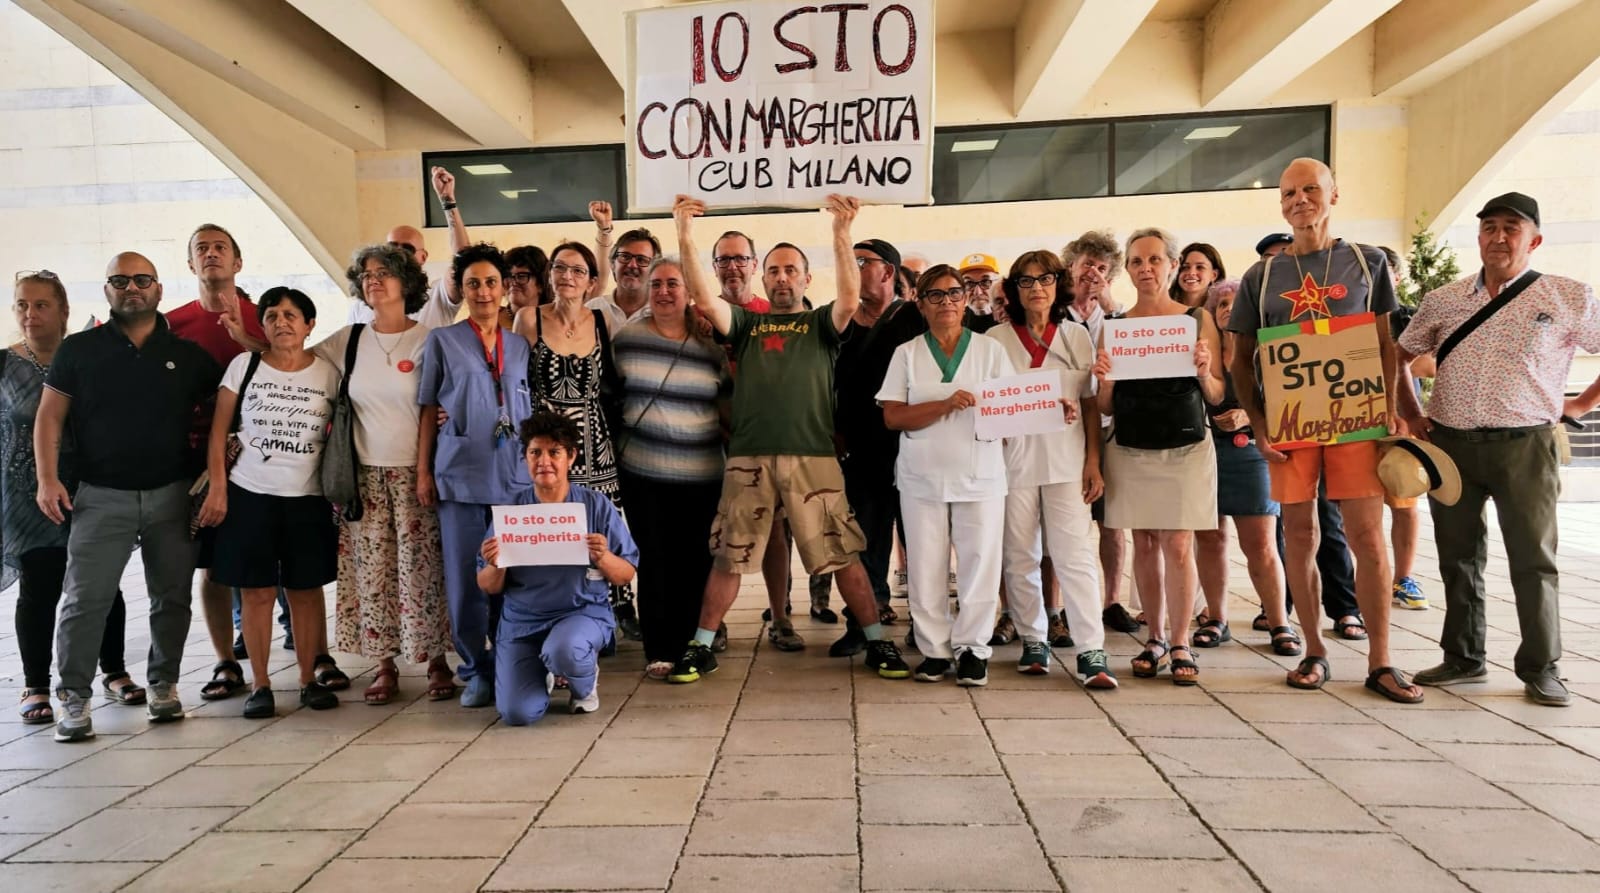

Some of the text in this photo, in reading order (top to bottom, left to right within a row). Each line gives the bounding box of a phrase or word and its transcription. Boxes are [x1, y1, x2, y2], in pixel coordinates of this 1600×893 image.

[692, 3, 917, 86] IO STO
[637, 94, 921, 159] CON MARGHERITA
[698, 154, 912, 192] CUB MILANO
[1114, 327, 1186, 339] Io sto con
[1111, 343, 1190, 357] Margherita
[1268, 342, 1300, 365] IO
[1283, 358, 1344, 390] STO
[251, 382, 278, 390] TUTTE
[297, 386, 326, 397] DONNE
[982, 383, 1051, 399] Io sto con
[1329, 376, 1384, 399] CON
[267, 391, 310, 402] NASCONO
[245, 399, 329, 419] Principesse
[980, 399, 1056, 416] Margherita
[252, 418, 267, 426] POI
[272, 418, 283, 427] LA
[287, 420, 308, 429] VITA
[1270, 395, 1387, 443] Margherita
[271, 428, 302, 438] RENDE
[504, 514, 576, 525] Io sto con
[501, 531, 581, 545] Margherita
